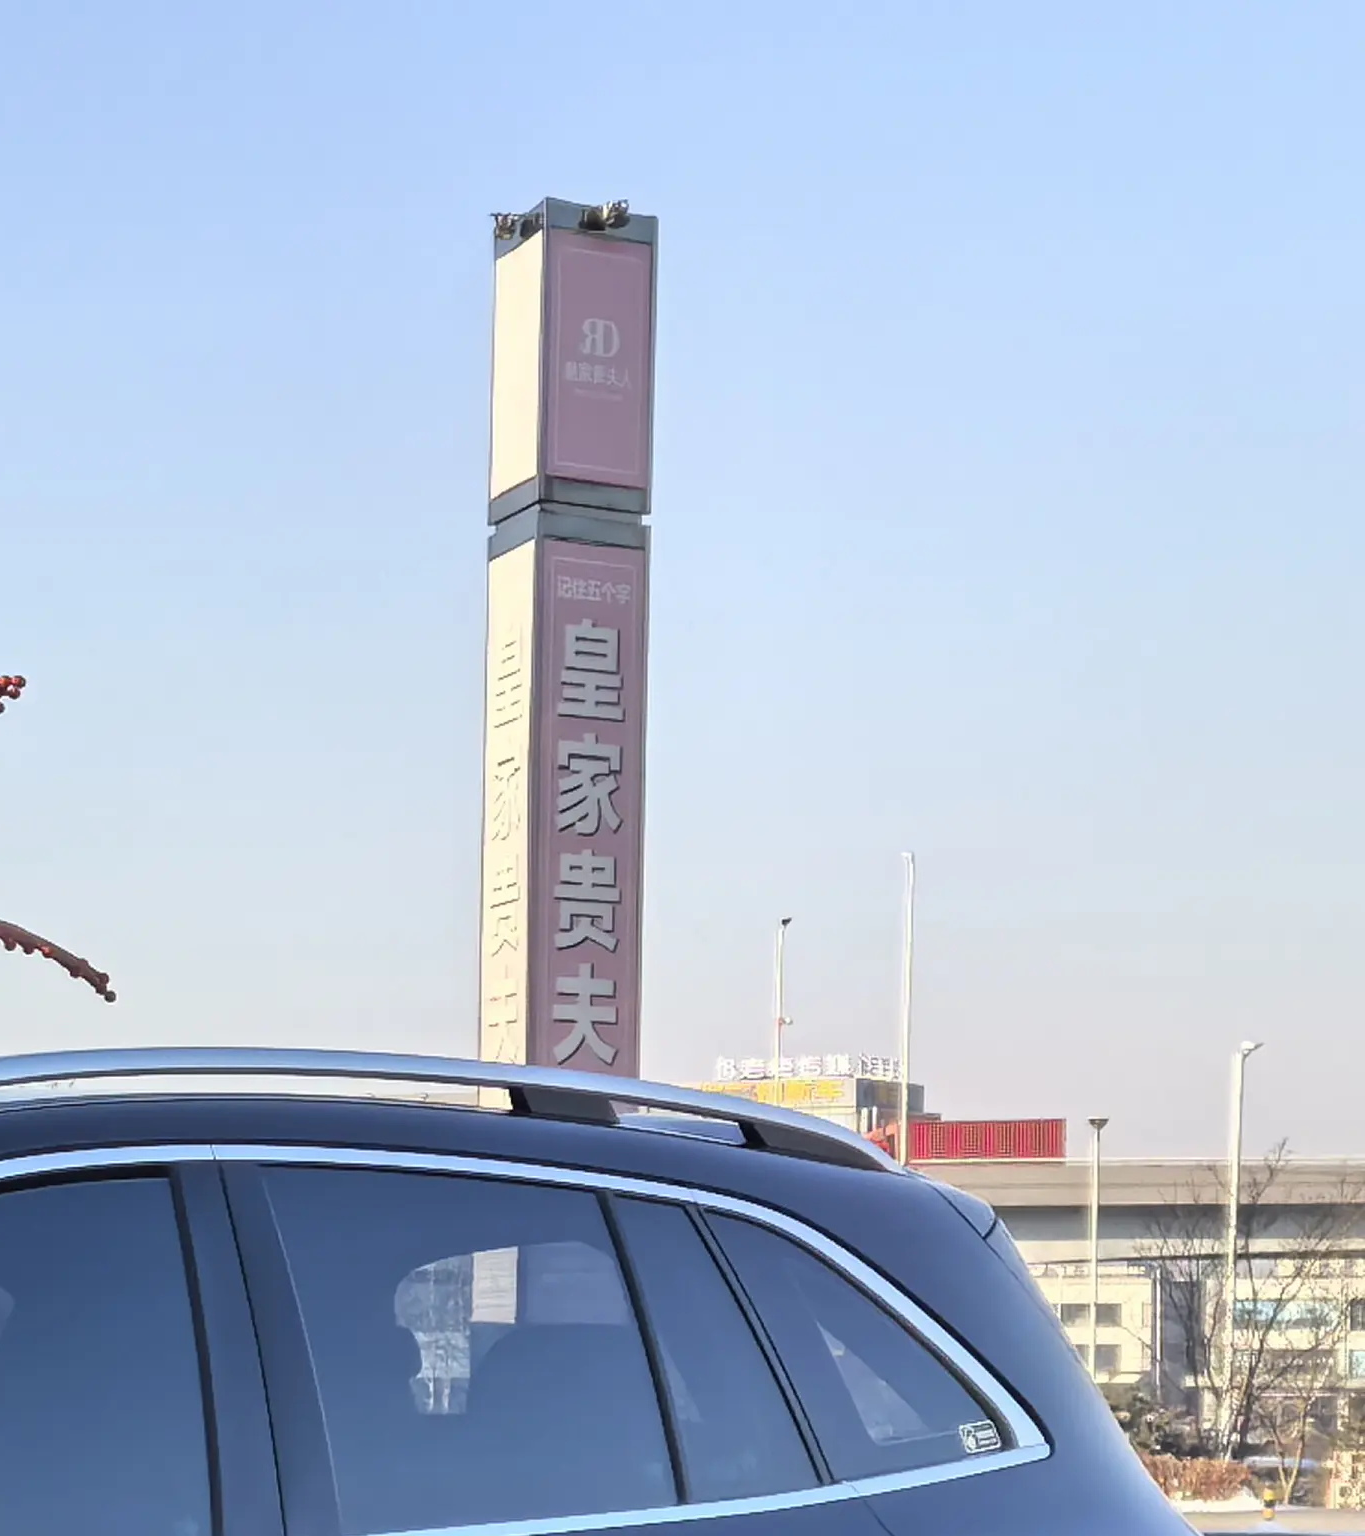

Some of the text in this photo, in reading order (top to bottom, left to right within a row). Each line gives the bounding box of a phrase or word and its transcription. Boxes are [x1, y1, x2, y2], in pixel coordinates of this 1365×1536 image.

[557, 575, 632, 605] 记住五个字
[553, 618, 625, 1068] 皇家贵夫
